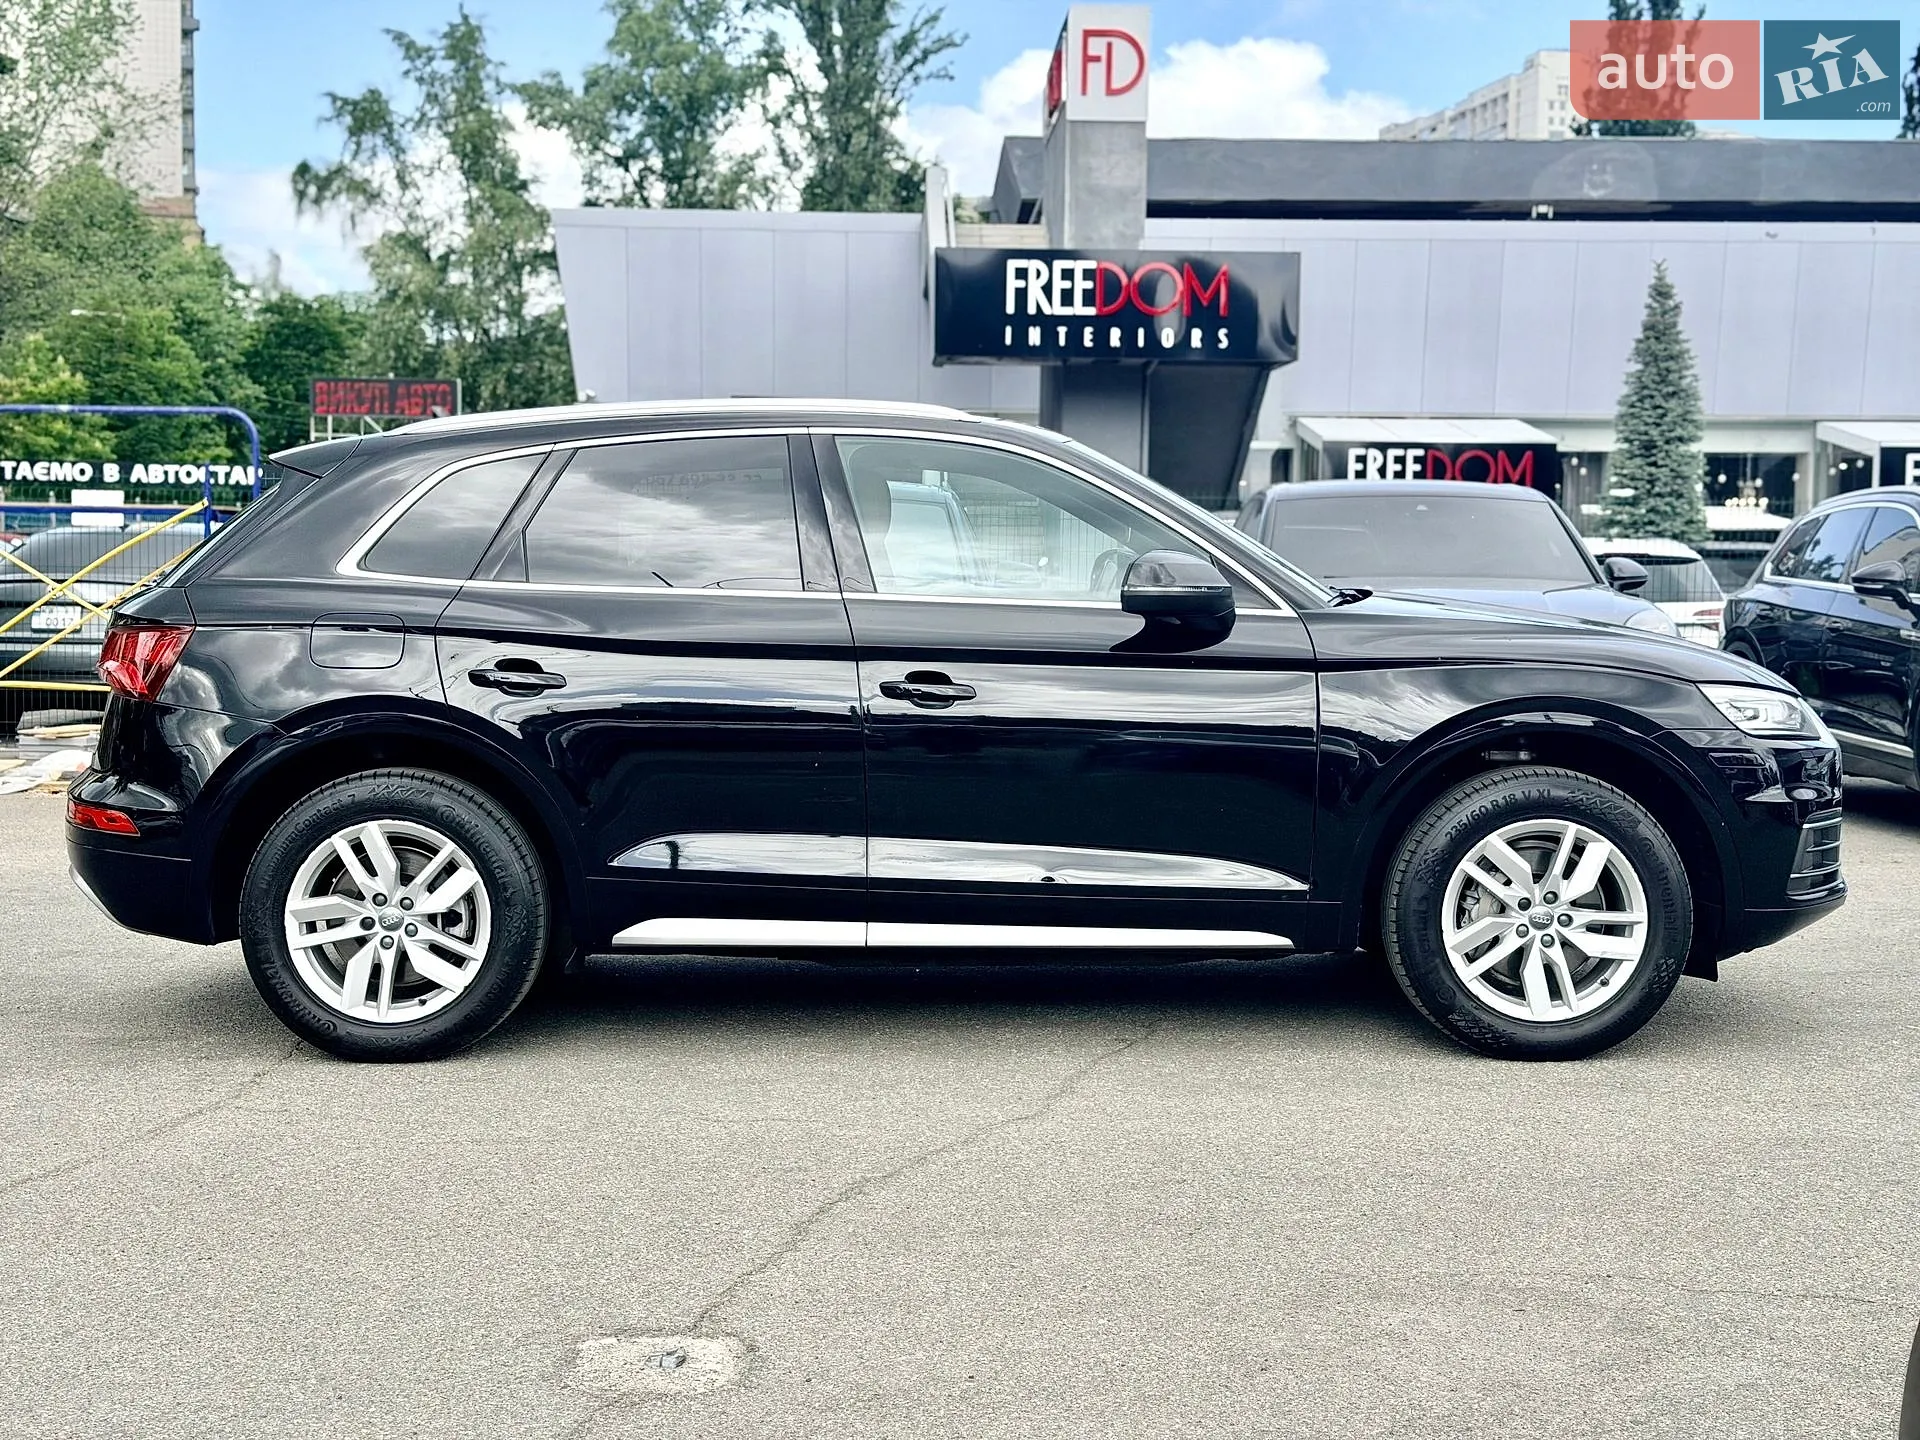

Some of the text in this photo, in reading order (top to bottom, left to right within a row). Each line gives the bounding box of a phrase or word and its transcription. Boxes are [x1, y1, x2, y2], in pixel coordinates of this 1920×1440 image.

[1081, 29, 1145, 96] FD
[1005, 258, 1229, 317] FREEDOM
[1004, 325, 1229, 349] INTERIORS
[315, 381, 452, 416] ВИКУП АВТО
[102, 463, 120, 483] В
[1347, 447, 1534, 487] FREEDOM
